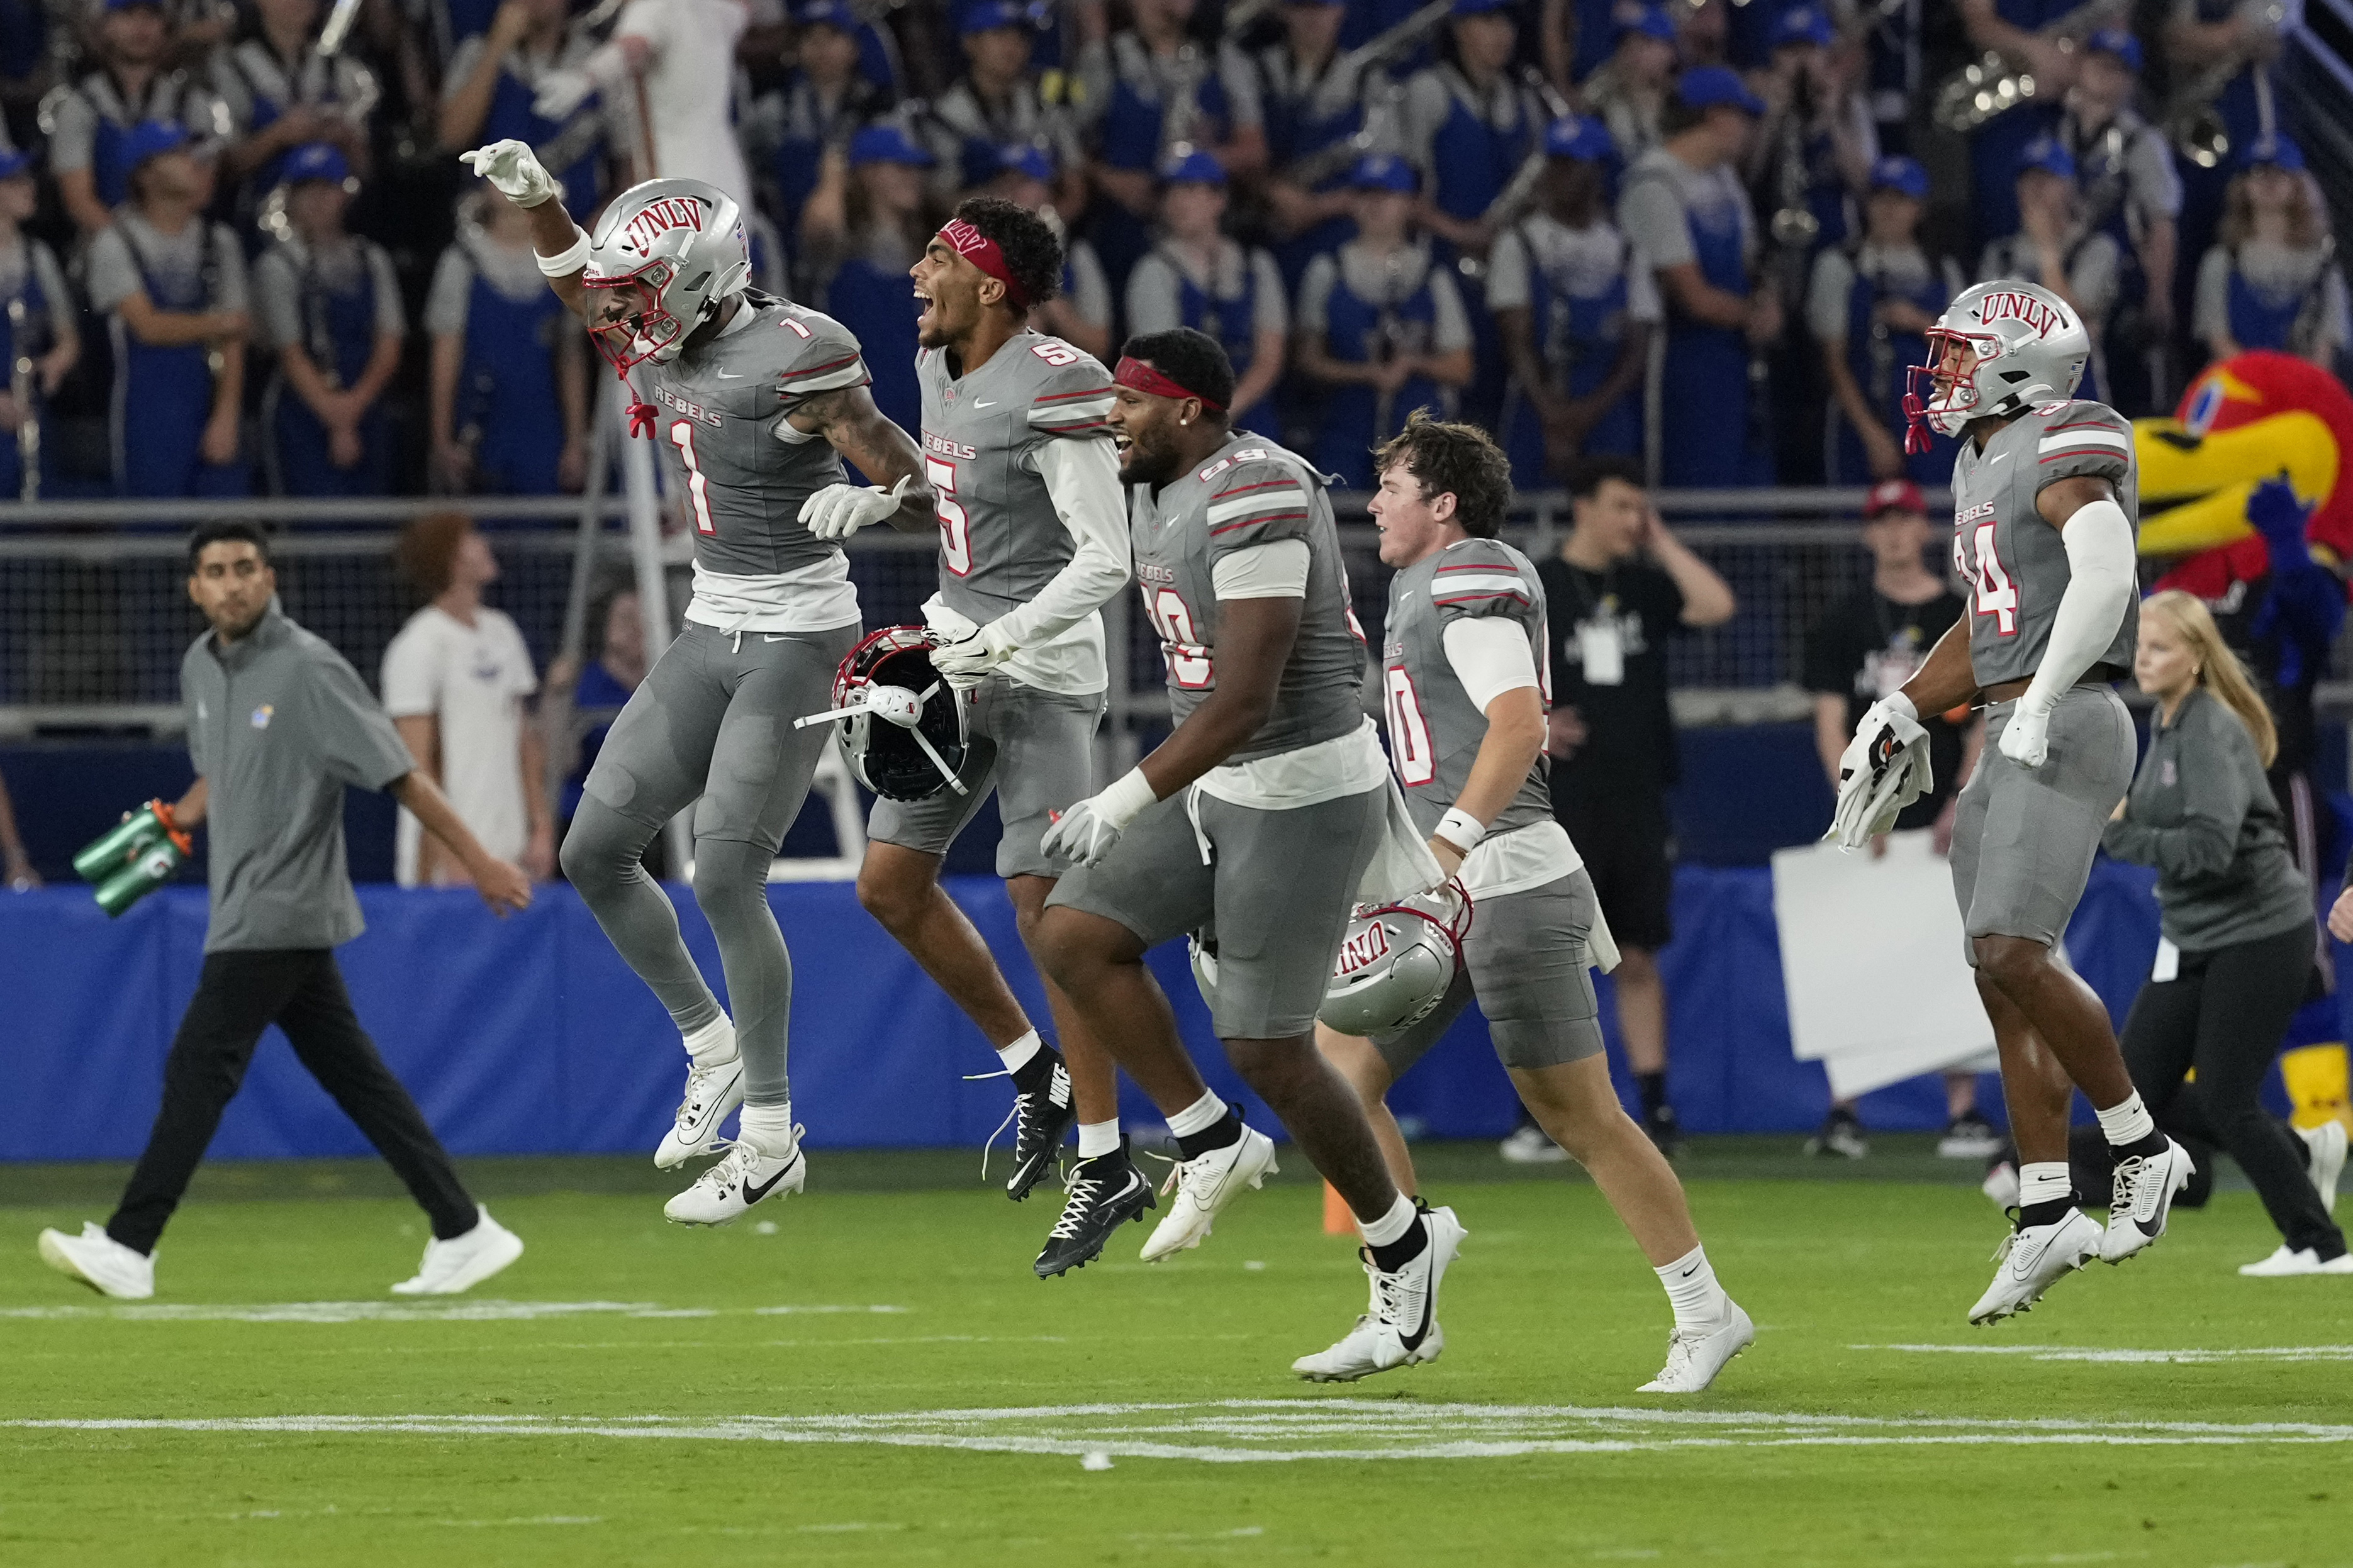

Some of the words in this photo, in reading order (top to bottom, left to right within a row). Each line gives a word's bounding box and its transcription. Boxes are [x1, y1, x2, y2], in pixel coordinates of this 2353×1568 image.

[623, 197, 704, 259] UNLV
[779, 316, 813, 338] 1
[1980, 292, 2058, 340] UNLV
[1031, 343, 1078, 366] 5
[654, 383, 723, 428] REBELS
[670, 418, 717, 537] 1
[925, 453, 974, 578] 5
[1954, 500, 1995, 526] EBELS
[1383, 664, 1437, 788] 0
[1048, 1062, 1071, 1110] NIKE
